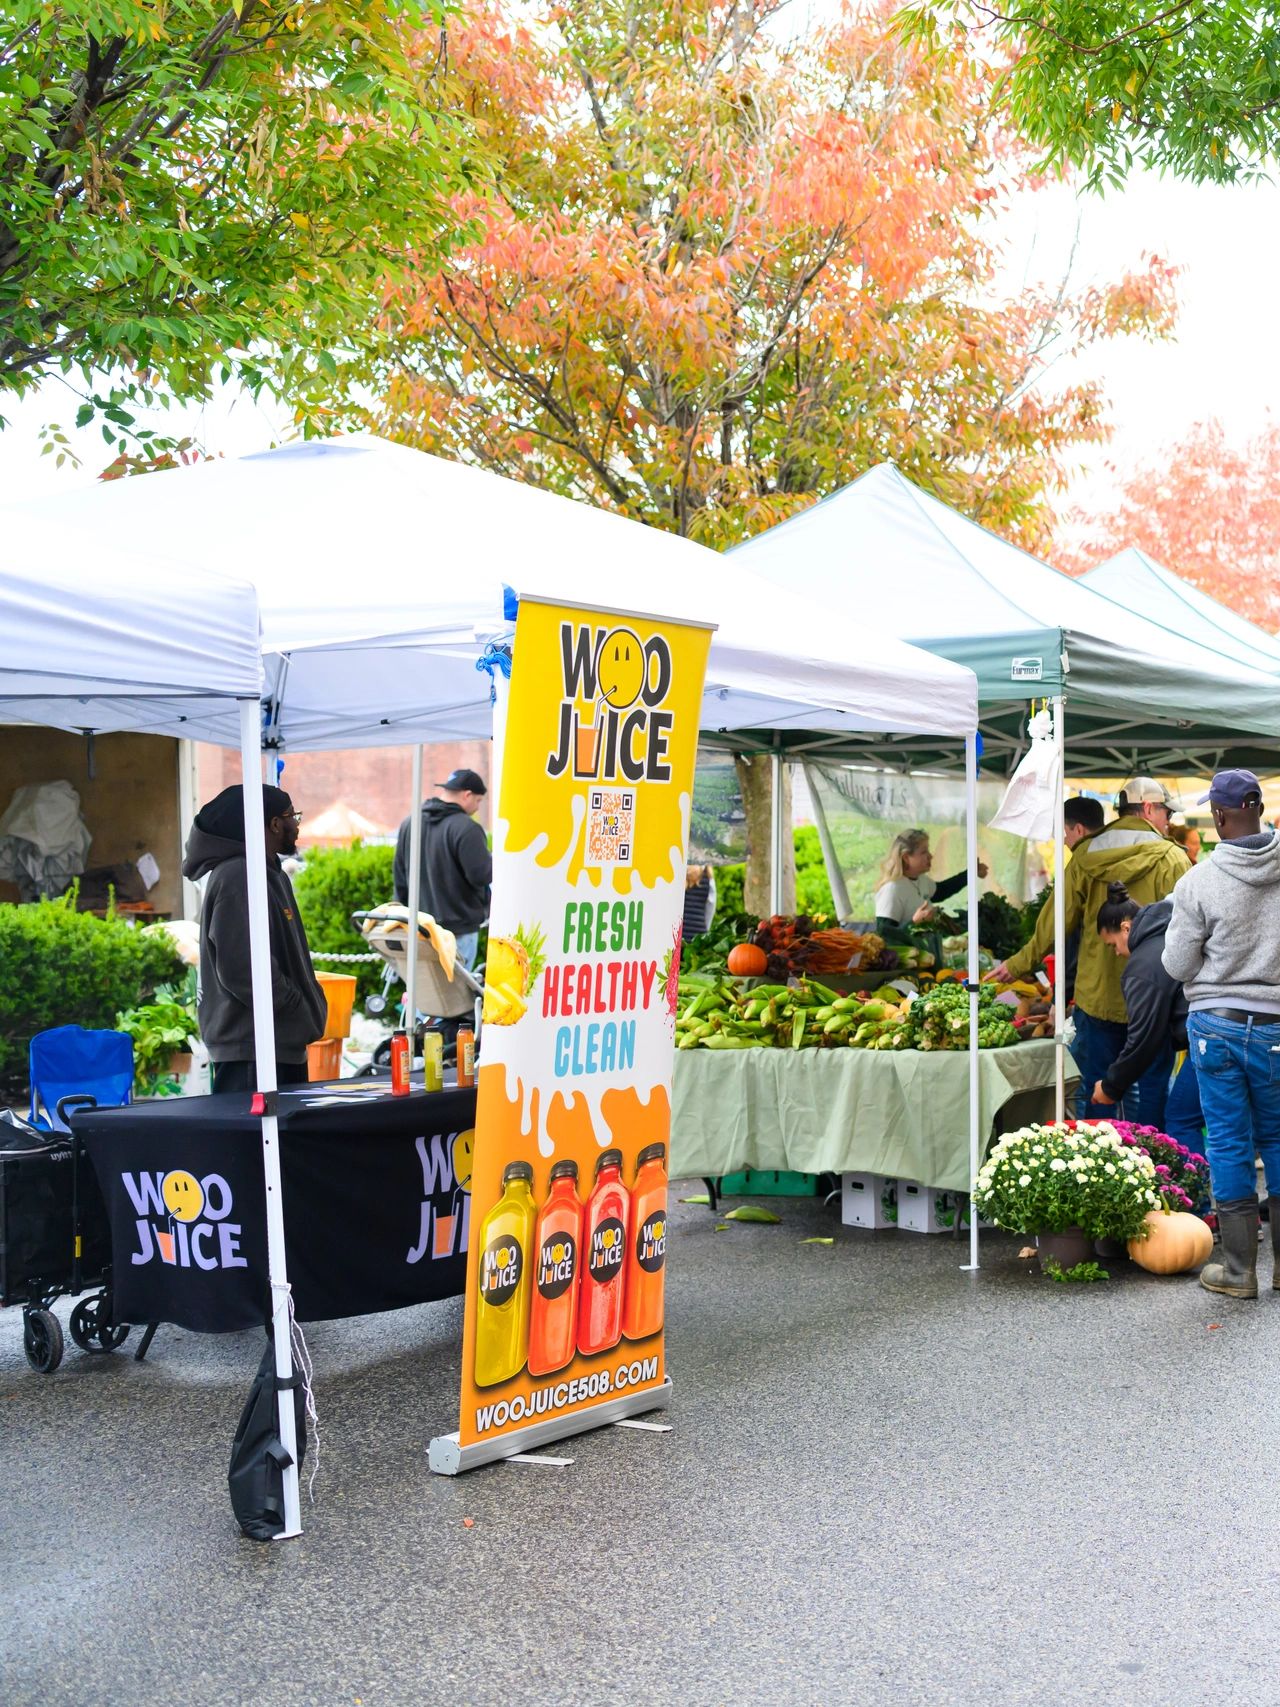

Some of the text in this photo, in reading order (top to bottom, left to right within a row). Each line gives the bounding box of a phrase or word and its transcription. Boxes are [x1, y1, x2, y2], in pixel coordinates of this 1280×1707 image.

[560, 622, 672, 710] WOO
[548, 704, 672, 780] JUICE
[562, 900, 644, 954] FRESH
[542, 960, 657, 1018] HEALTHY
[553, 1020, 636, 1077] CLEAN
[121, 1169, 233, 1223] WOO
[130, 1220, 248, 1270] JUICE
[484, 1244, 517, 1270] WOO
[541, 1242, 572, 1265] WOO
[590, 1245, 622, 1270] JUICE
[592, 1227, 622, 1249] WOO
[481, 1264, 517, 1291] JUICE
[538, 1259, 572, 1285] JUICE
[475, 1356, 659, 1433] WOOJUICE508.COM
